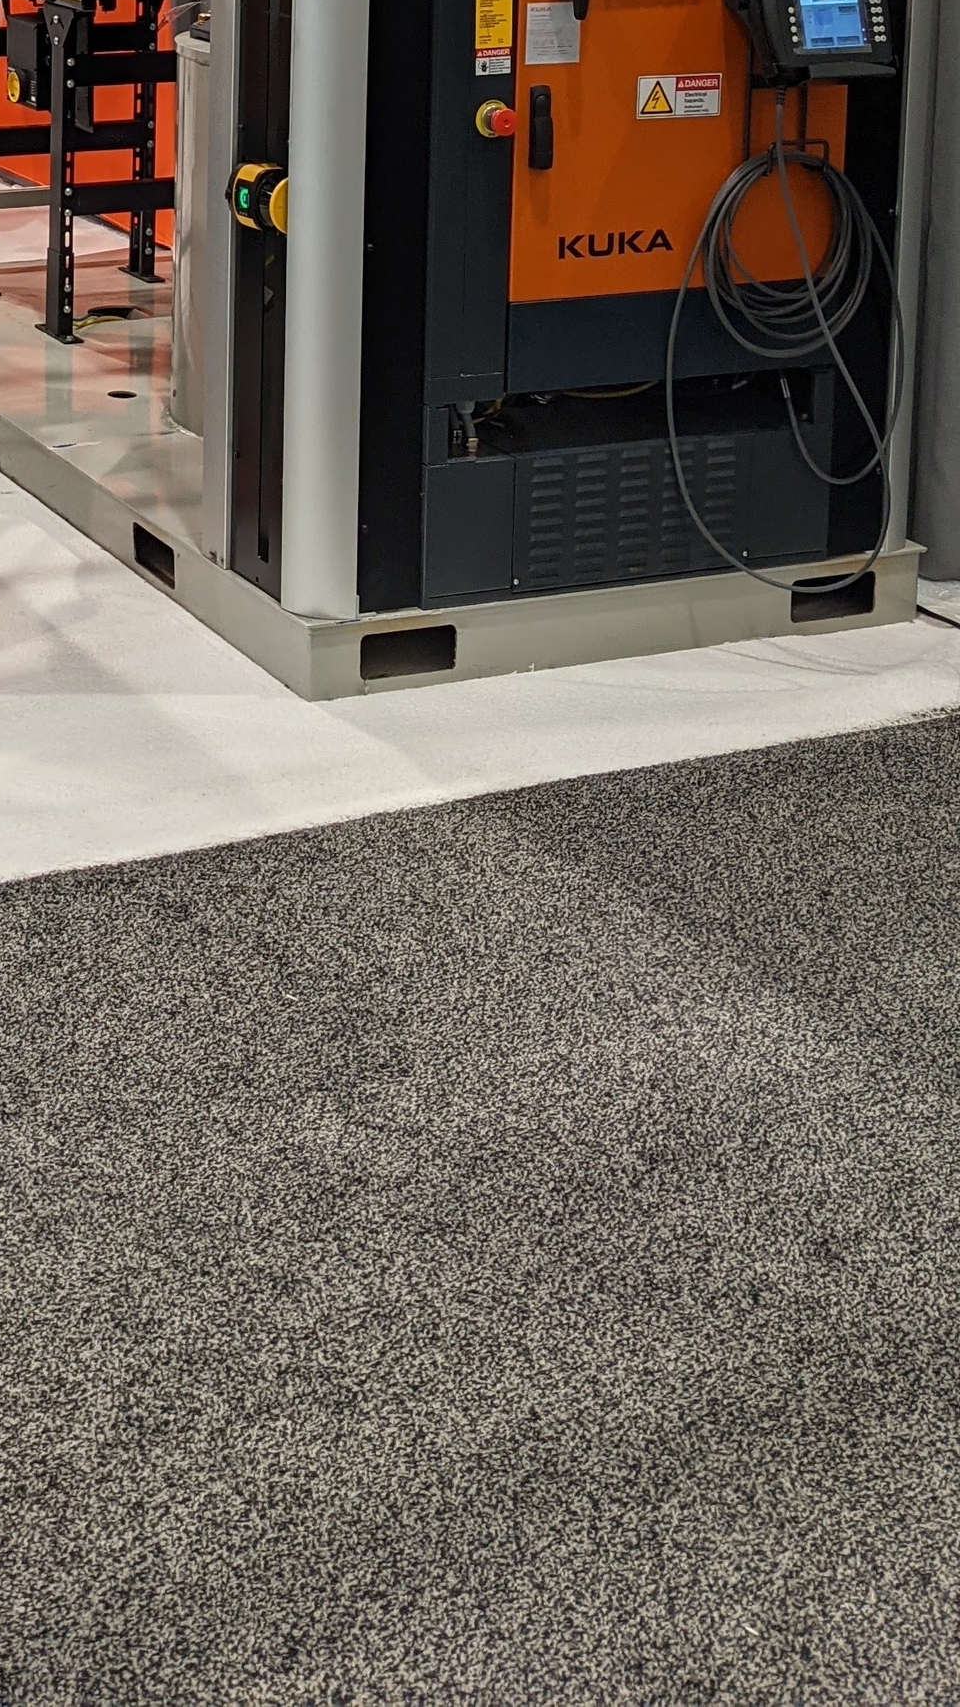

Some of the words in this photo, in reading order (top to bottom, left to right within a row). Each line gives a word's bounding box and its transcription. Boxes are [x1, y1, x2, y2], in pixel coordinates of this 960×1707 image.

[483, 49, 510, 57] DANGER
[685, 79, 718, 88] DANGER
[558, 228, 674, 260] KUKA
